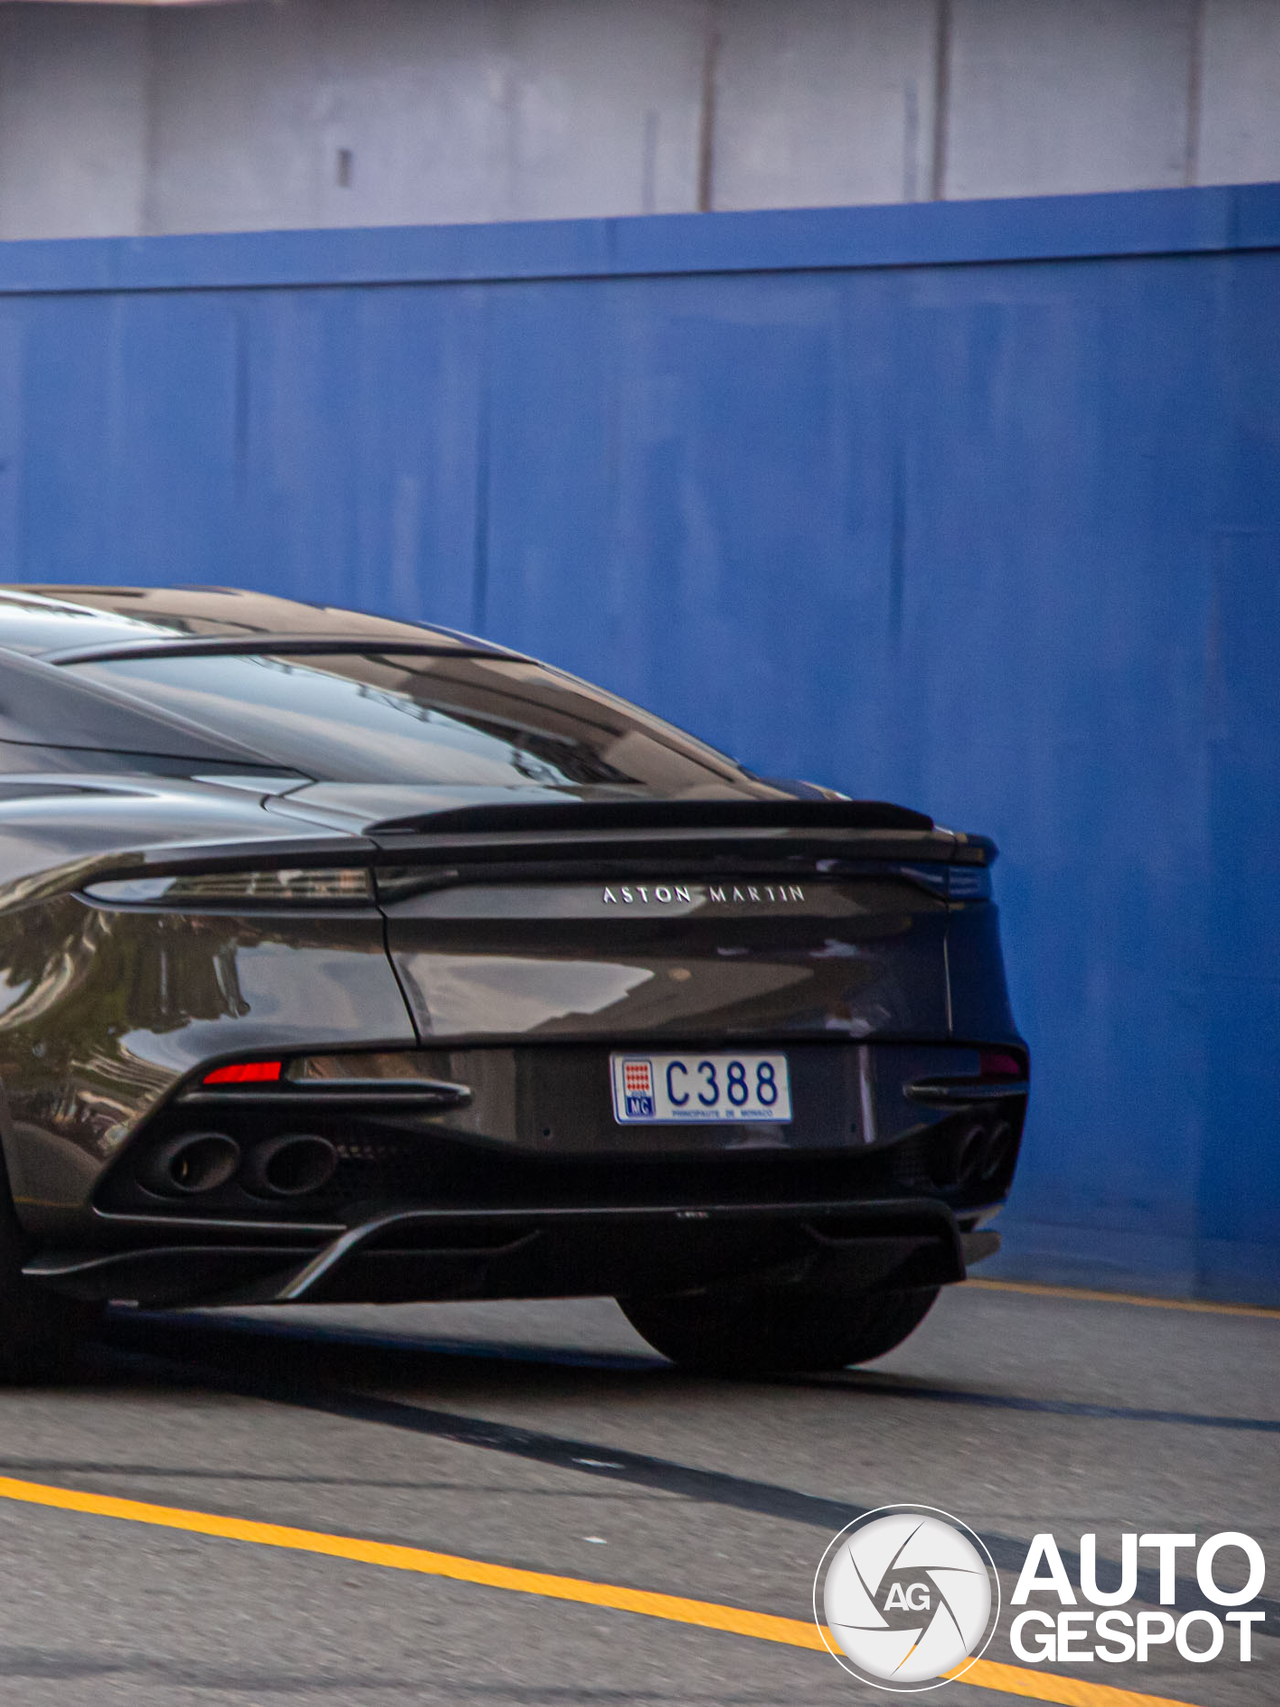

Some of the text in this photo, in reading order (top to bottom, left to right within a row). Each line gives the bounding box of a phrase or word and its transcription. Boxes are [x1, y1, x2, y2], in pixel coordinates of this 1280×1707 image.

[603, 886, 805, 903] ASTON MARTIN
[666, 1060, 778, 1107] C388
[630, 1098, 651, 1115] MC
